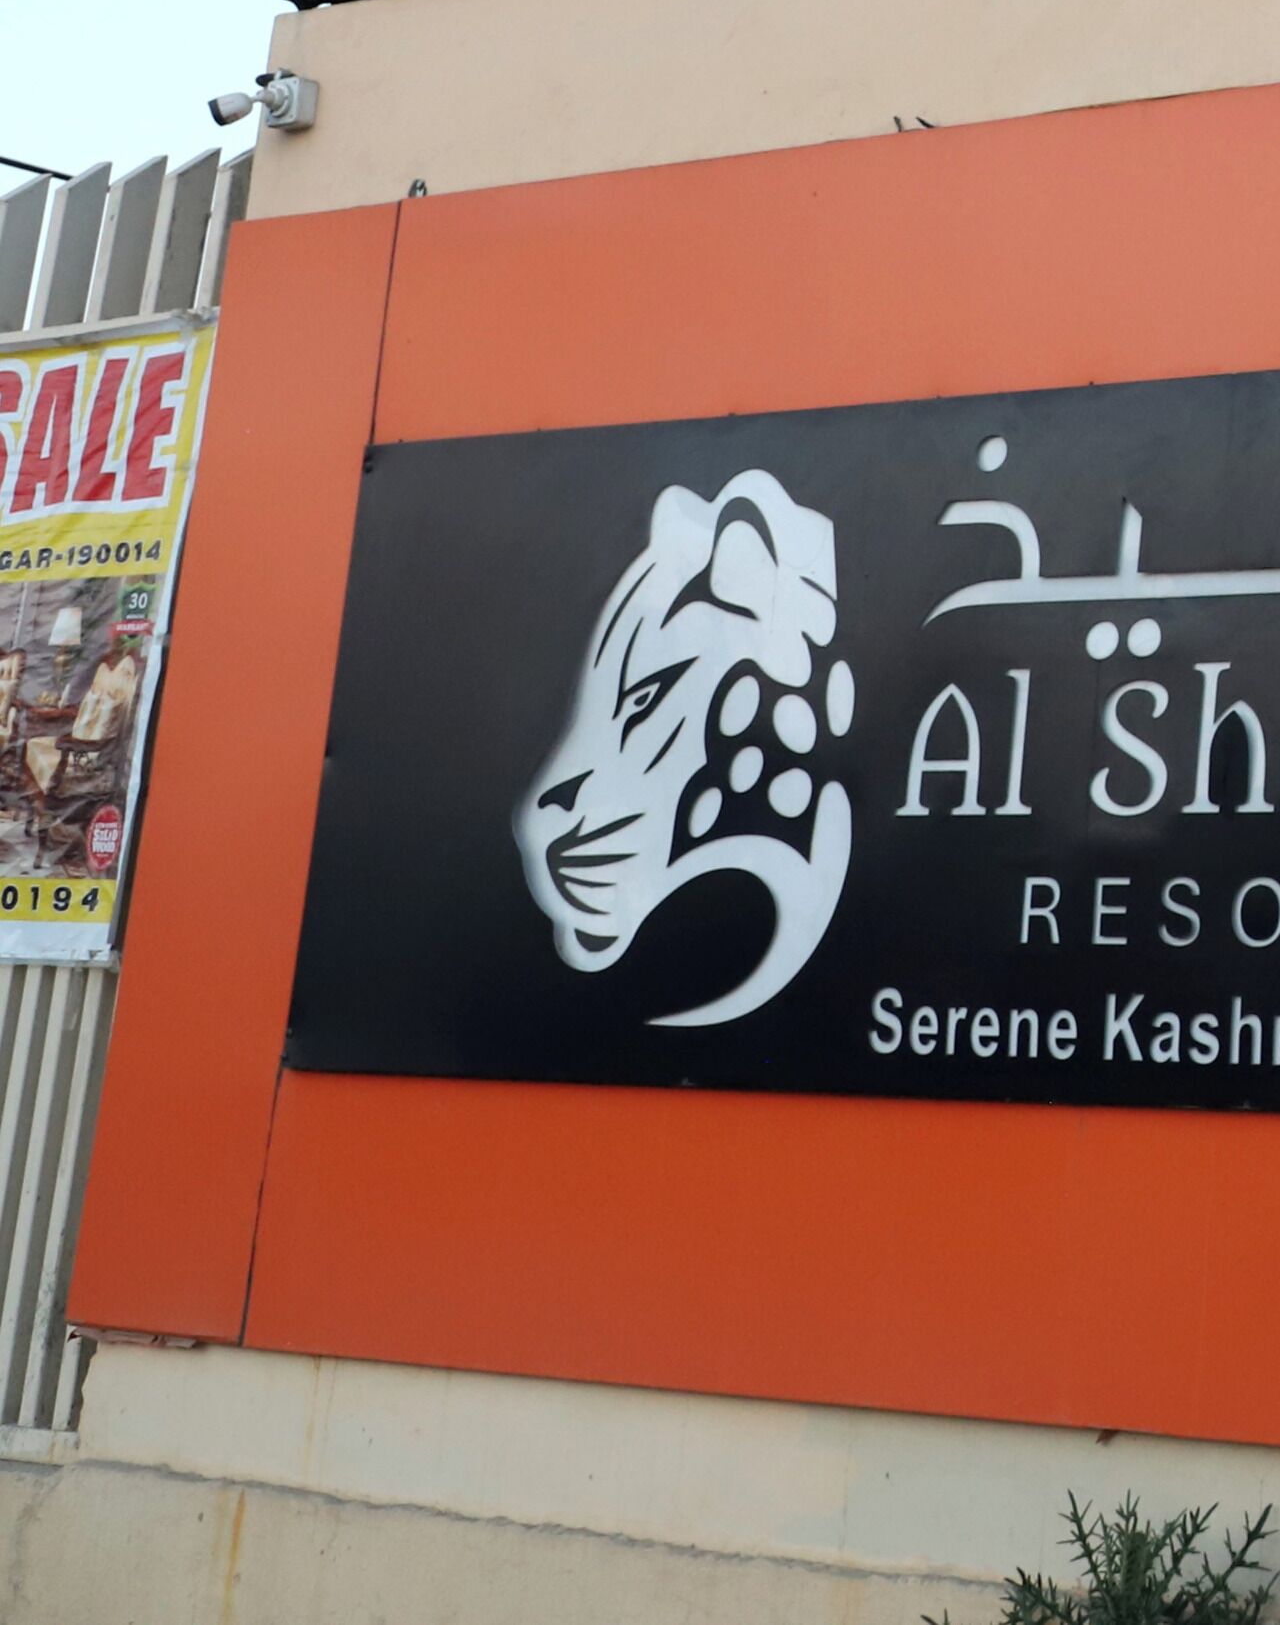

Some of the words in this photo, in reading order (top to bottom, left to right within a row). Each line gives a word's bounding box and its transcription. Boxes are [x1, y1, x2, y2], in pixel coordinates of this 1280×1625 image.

[128, 592, 148, 609] 30
[894, 667, 1032, 816] Al
[868, 988, 1078, 1061] Serene
